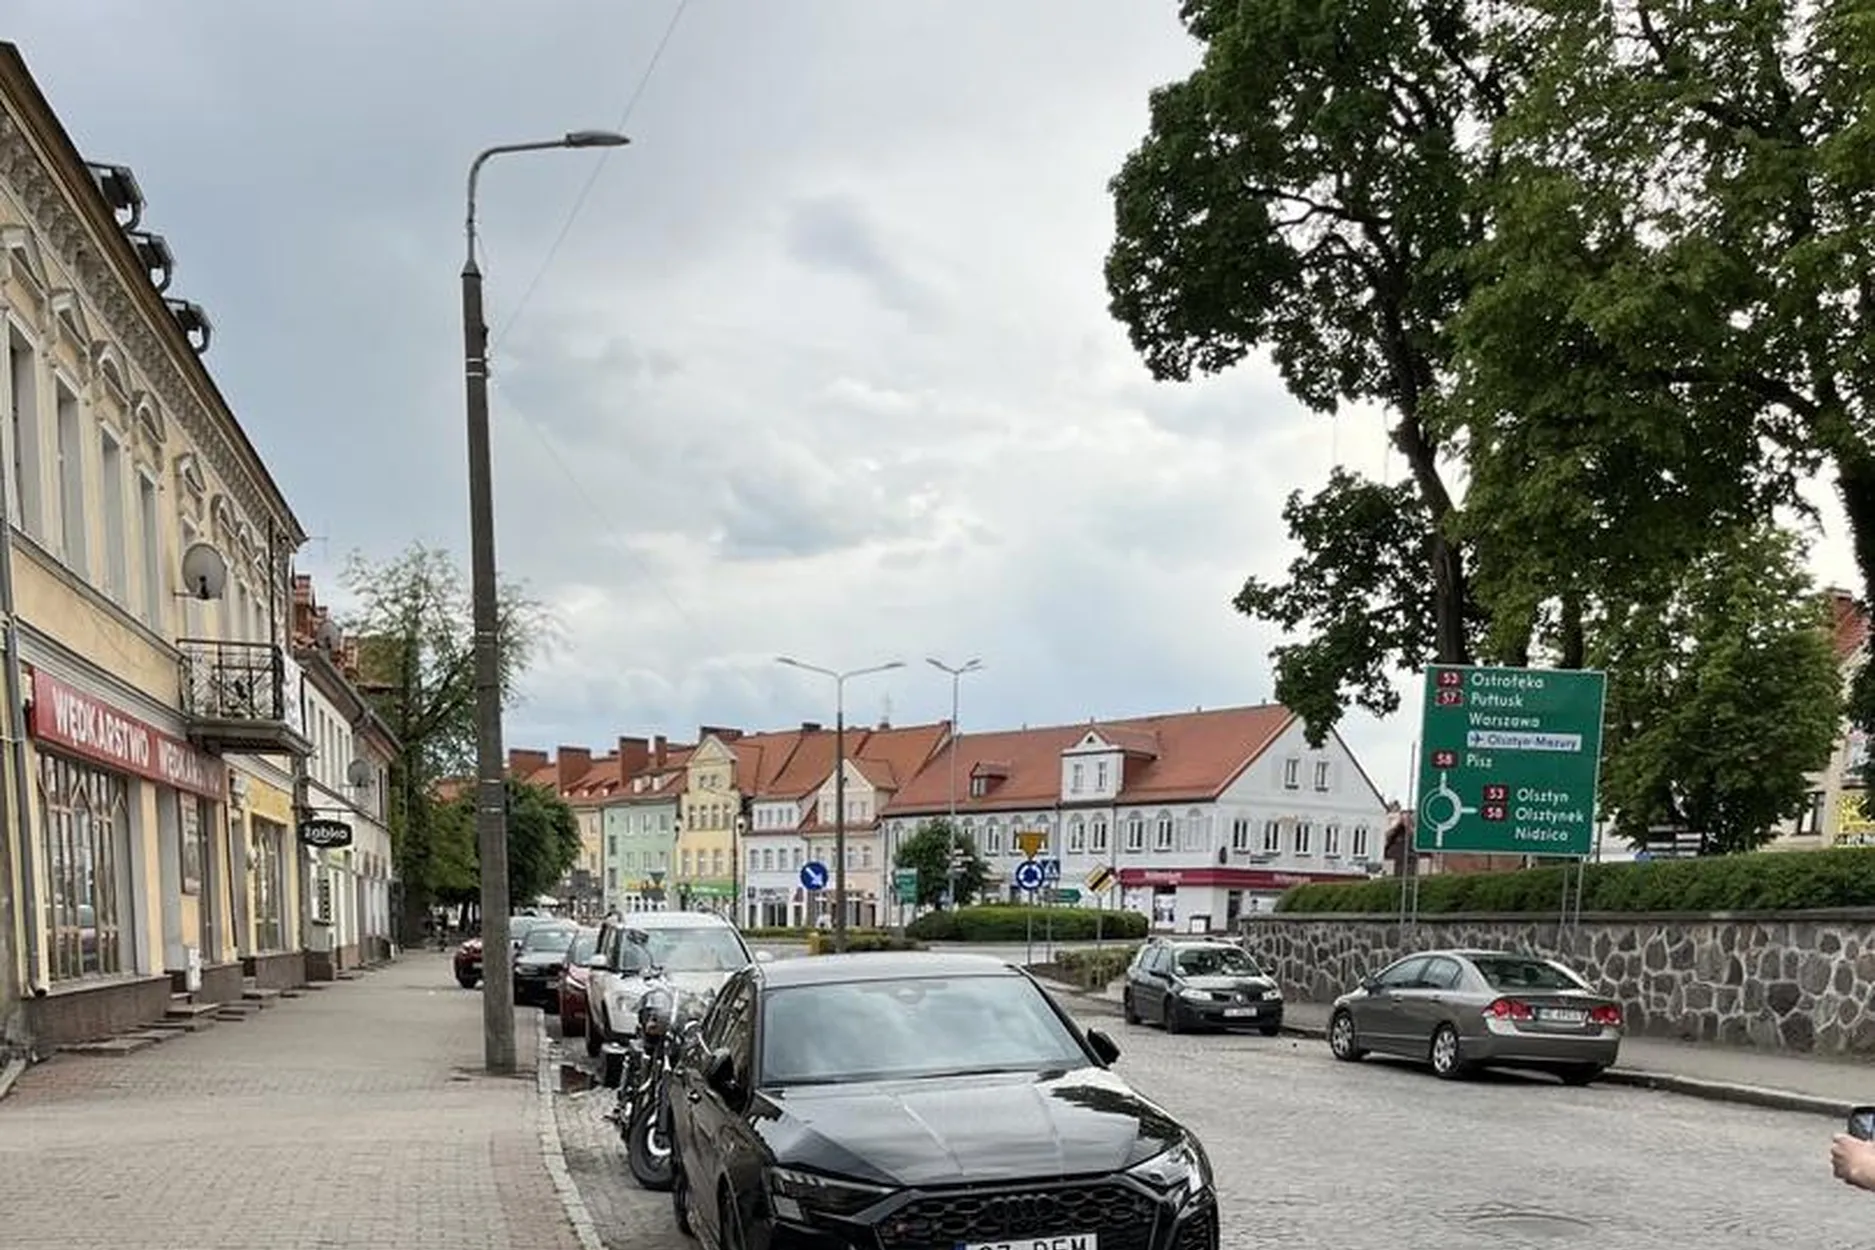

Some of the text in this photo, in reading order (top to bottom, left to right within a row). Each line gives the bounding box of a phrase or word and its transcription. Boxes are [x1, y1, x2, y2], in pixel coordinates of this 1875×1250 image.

[52, 684, 149, 768] WĘDKARSTWO
[1469, 712, 1539, 727] Warszawa
[1467, 755, 1492, 768] Pisz
[1517, 788, 1568, 805] Olsztyn
[1516, 807, 1584, 823] Olsztynek
[1515, 828, 1568, 841] Nidzica
